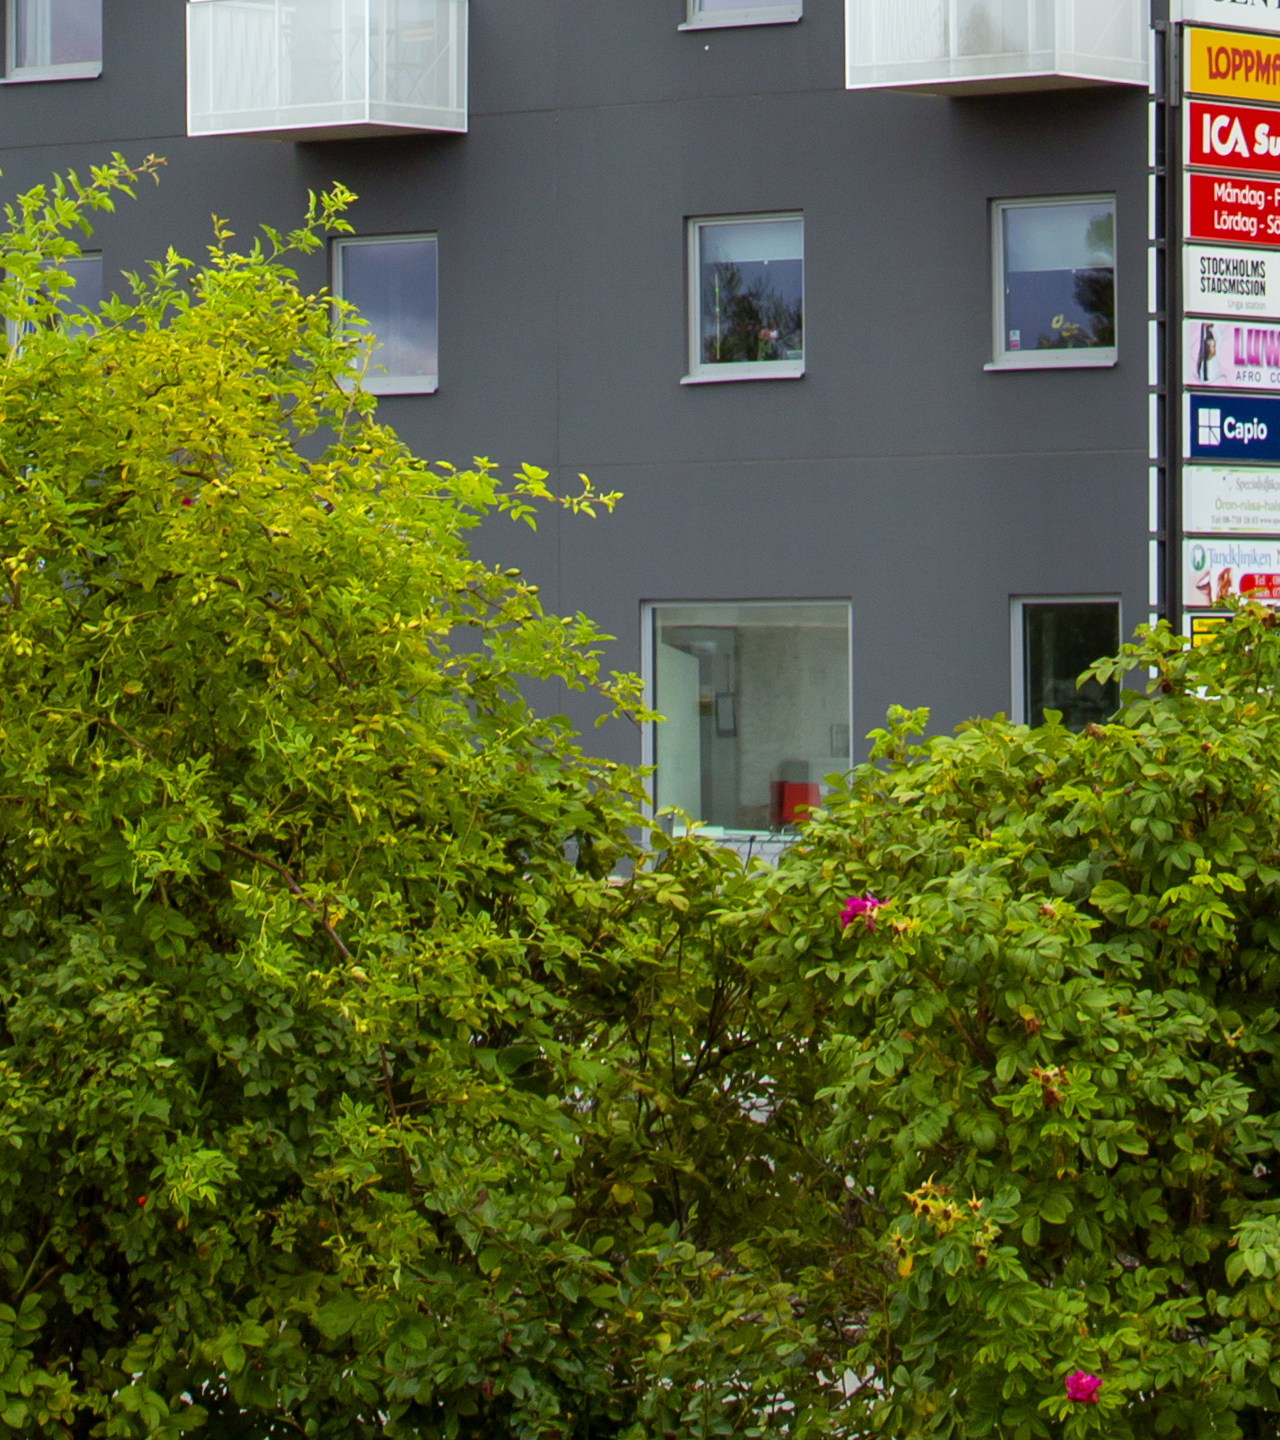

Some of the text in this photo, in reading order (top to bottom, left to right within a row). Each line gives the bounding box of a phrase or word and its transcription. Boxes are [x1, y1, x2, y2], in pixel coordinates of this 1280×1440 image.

[1202, 113, 1250, 158] ICA
[1214, 182, 1265, 210] Måndag
[1214, 210, 1257, 237] Lördag
[1200, 256, 1266, 278] STOCKHOLMS
[1200, 277, 1266, 296] STADSMISSION
[1236, 371, 1261, 382] AFRO
[1223, 416, 1267, 444] Capio
[1207, 544, 1270, 568] Tandkliniken
